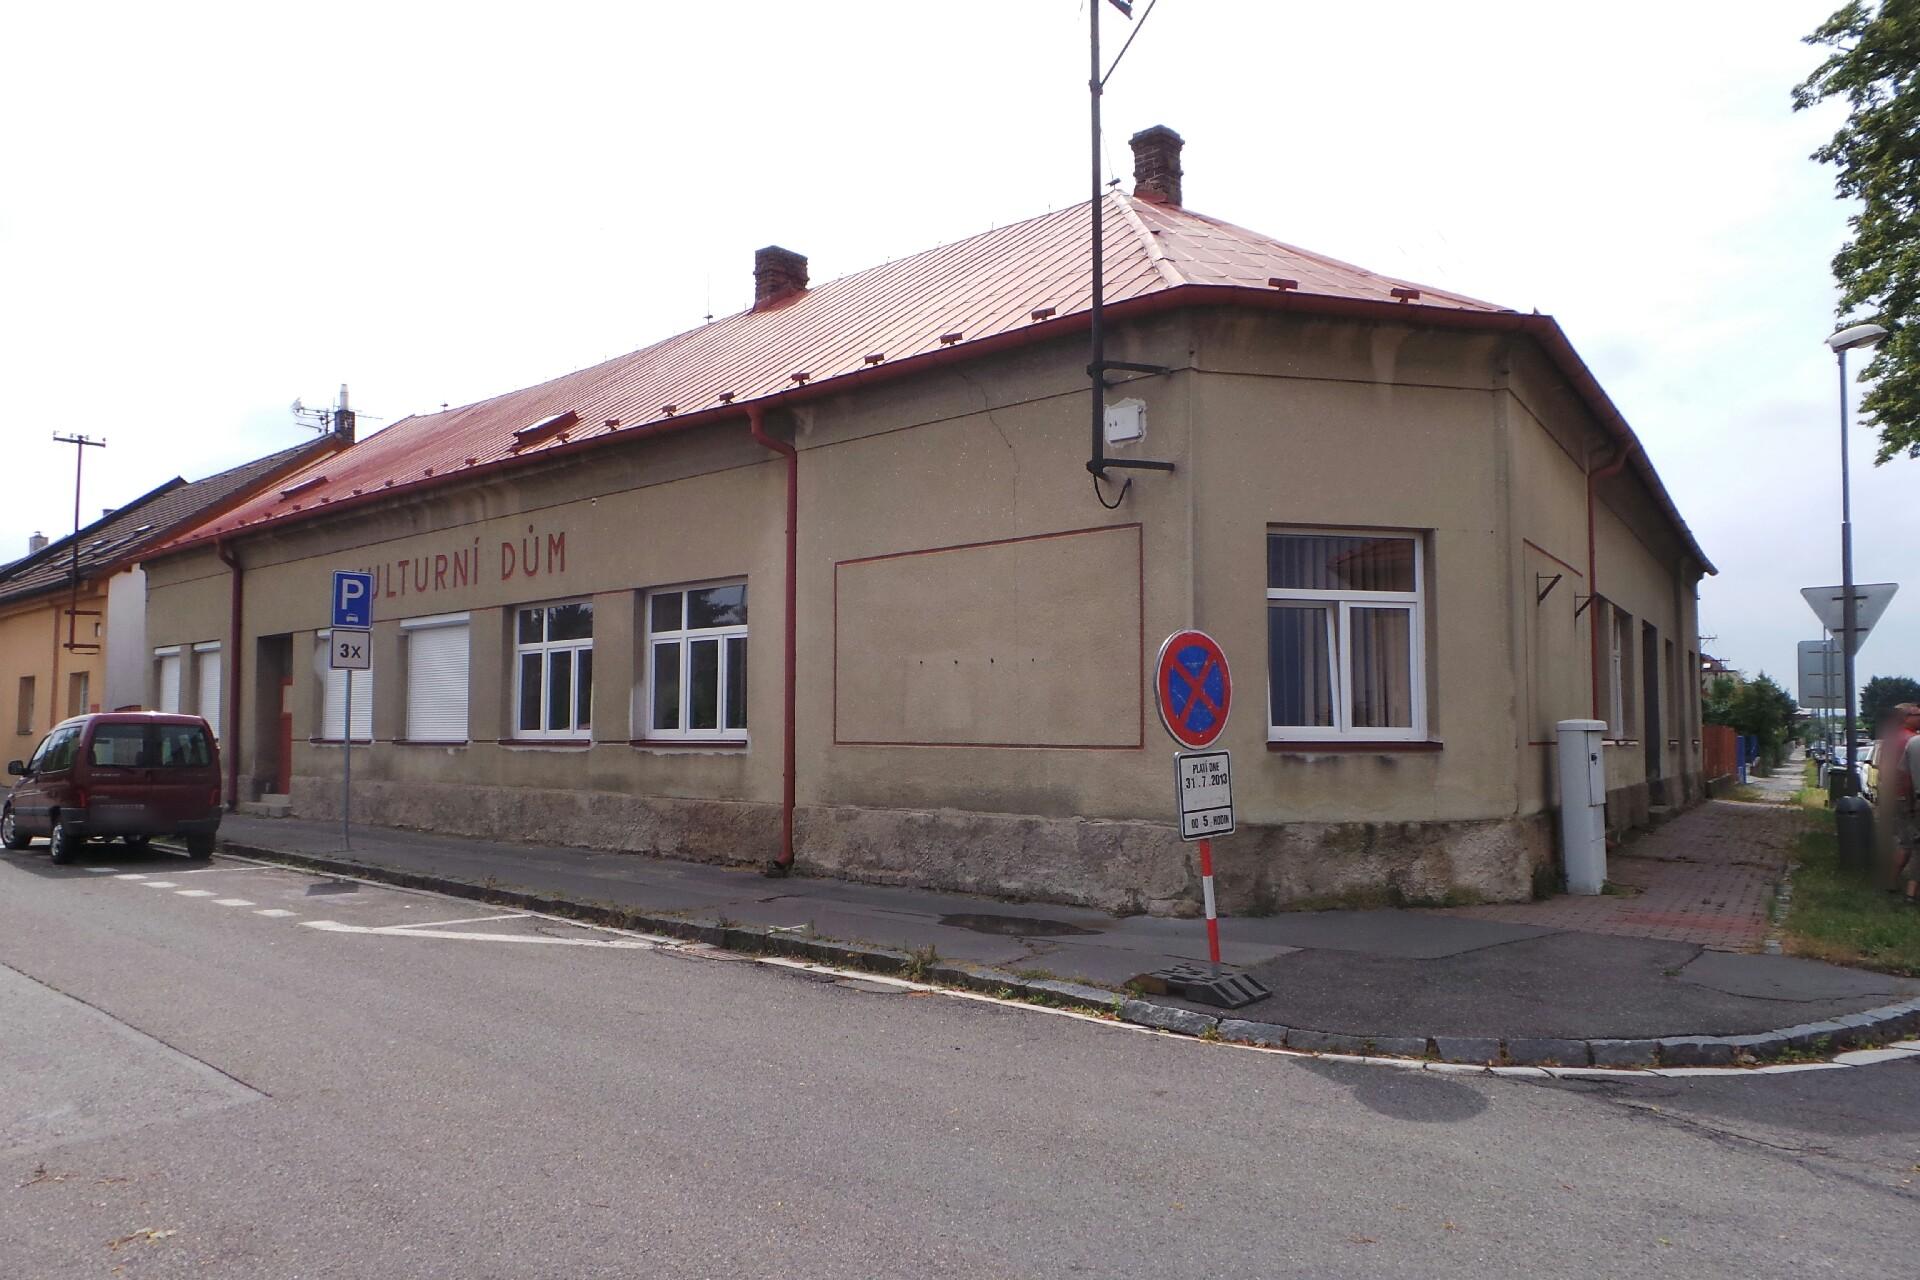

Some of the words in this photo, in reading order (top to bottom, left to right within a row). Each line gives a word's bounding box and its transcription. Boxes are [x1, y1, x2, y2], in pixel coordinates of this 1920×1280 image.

[356, 537, 480, 599] ULTURNÍ
[501, 525, 565, 581] DŮM
[341, 578, 364, 610] P
[1192, 760, 1208, 774] PLATÍ
[1202, 815, 1209, 827] 5
